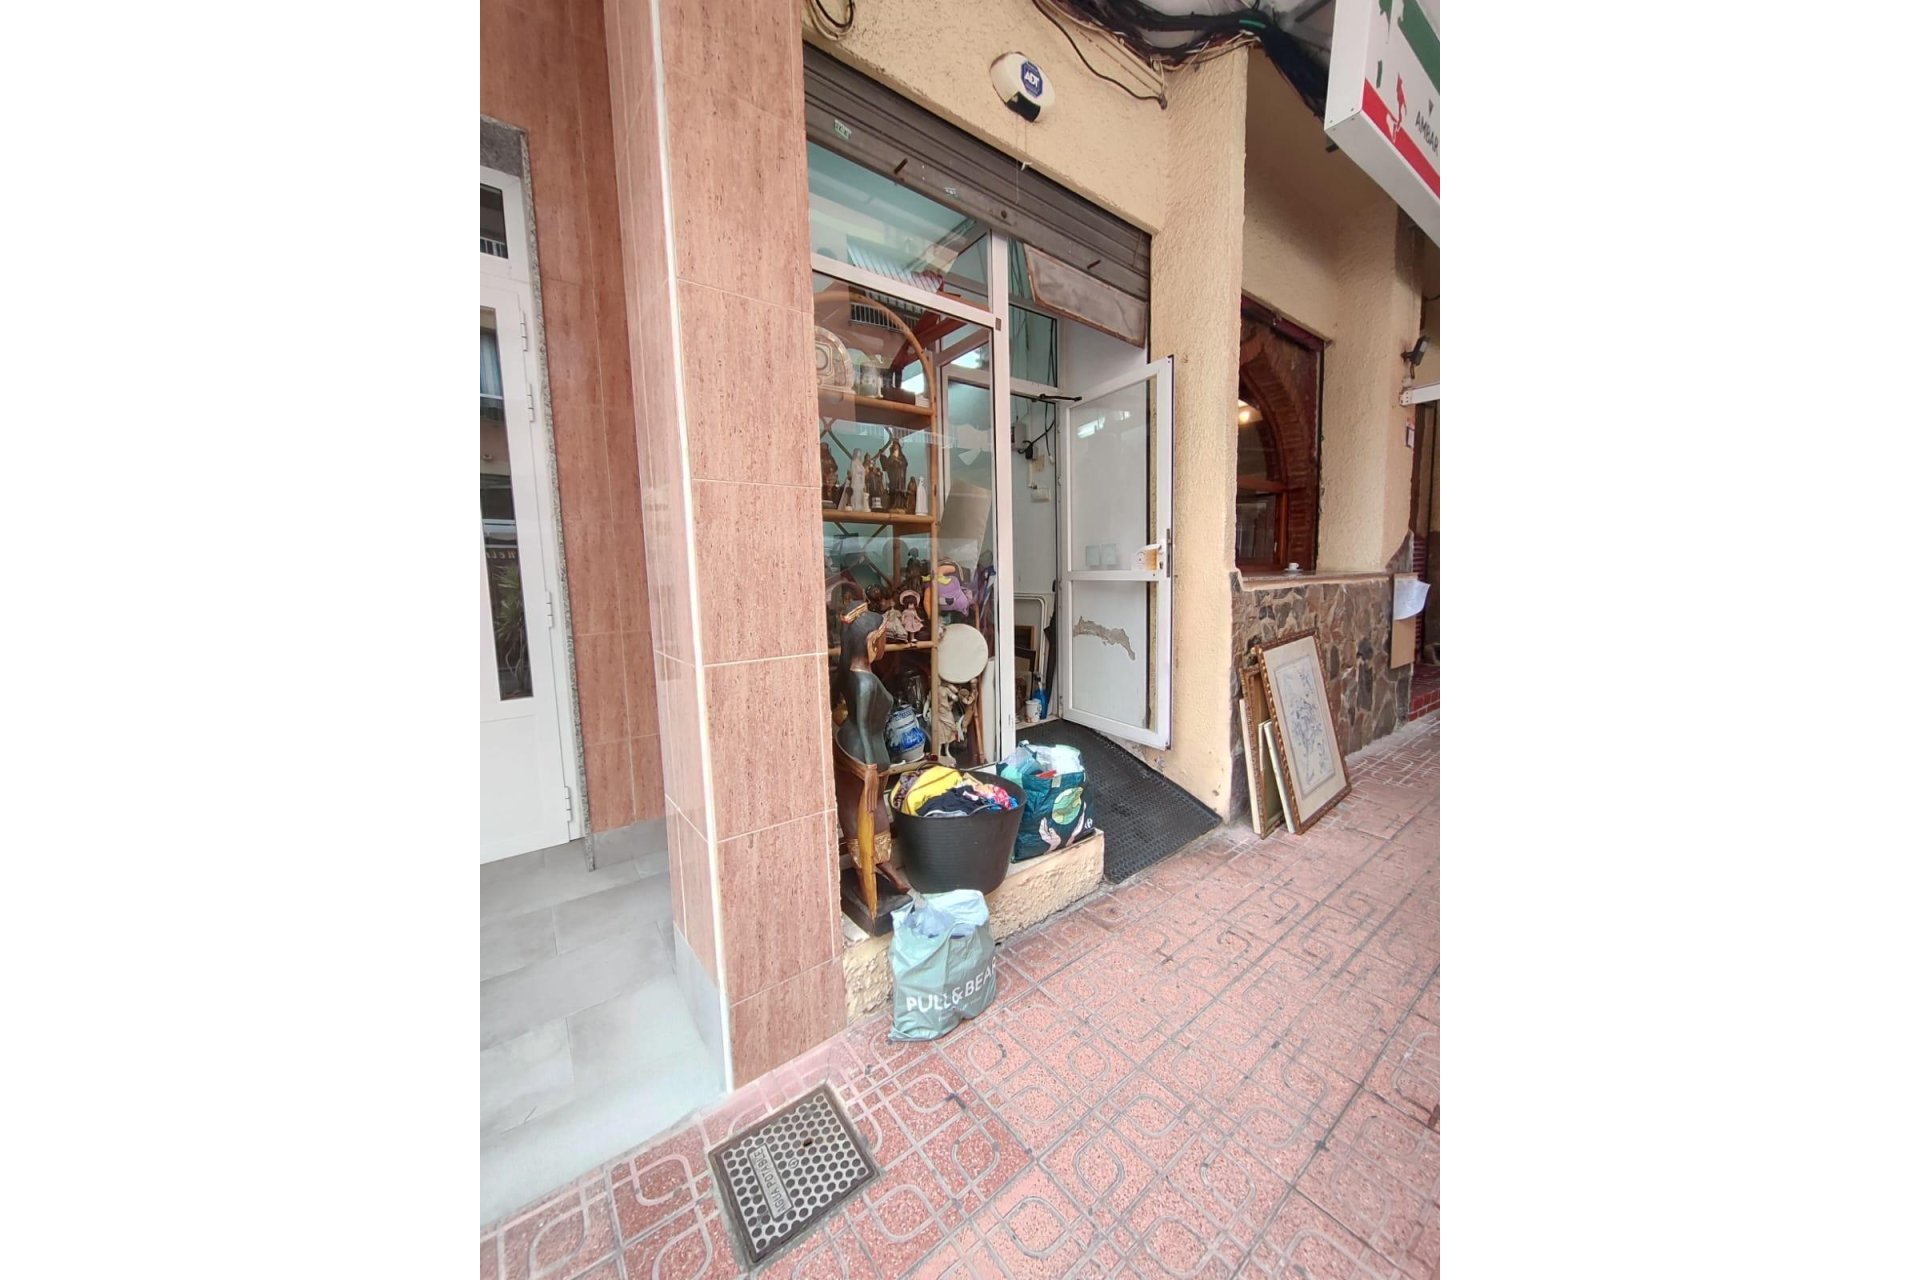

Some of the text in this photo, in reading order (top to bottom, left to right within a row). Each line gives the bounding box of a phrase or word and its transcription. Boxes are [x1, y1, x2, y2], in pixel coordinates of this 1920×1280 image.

[1024, 71, 1040, 88] ADT
[1415, 110, 1439, 156] AMBAR
[753, 1148, 787, 1213] AGUA POTABLE
